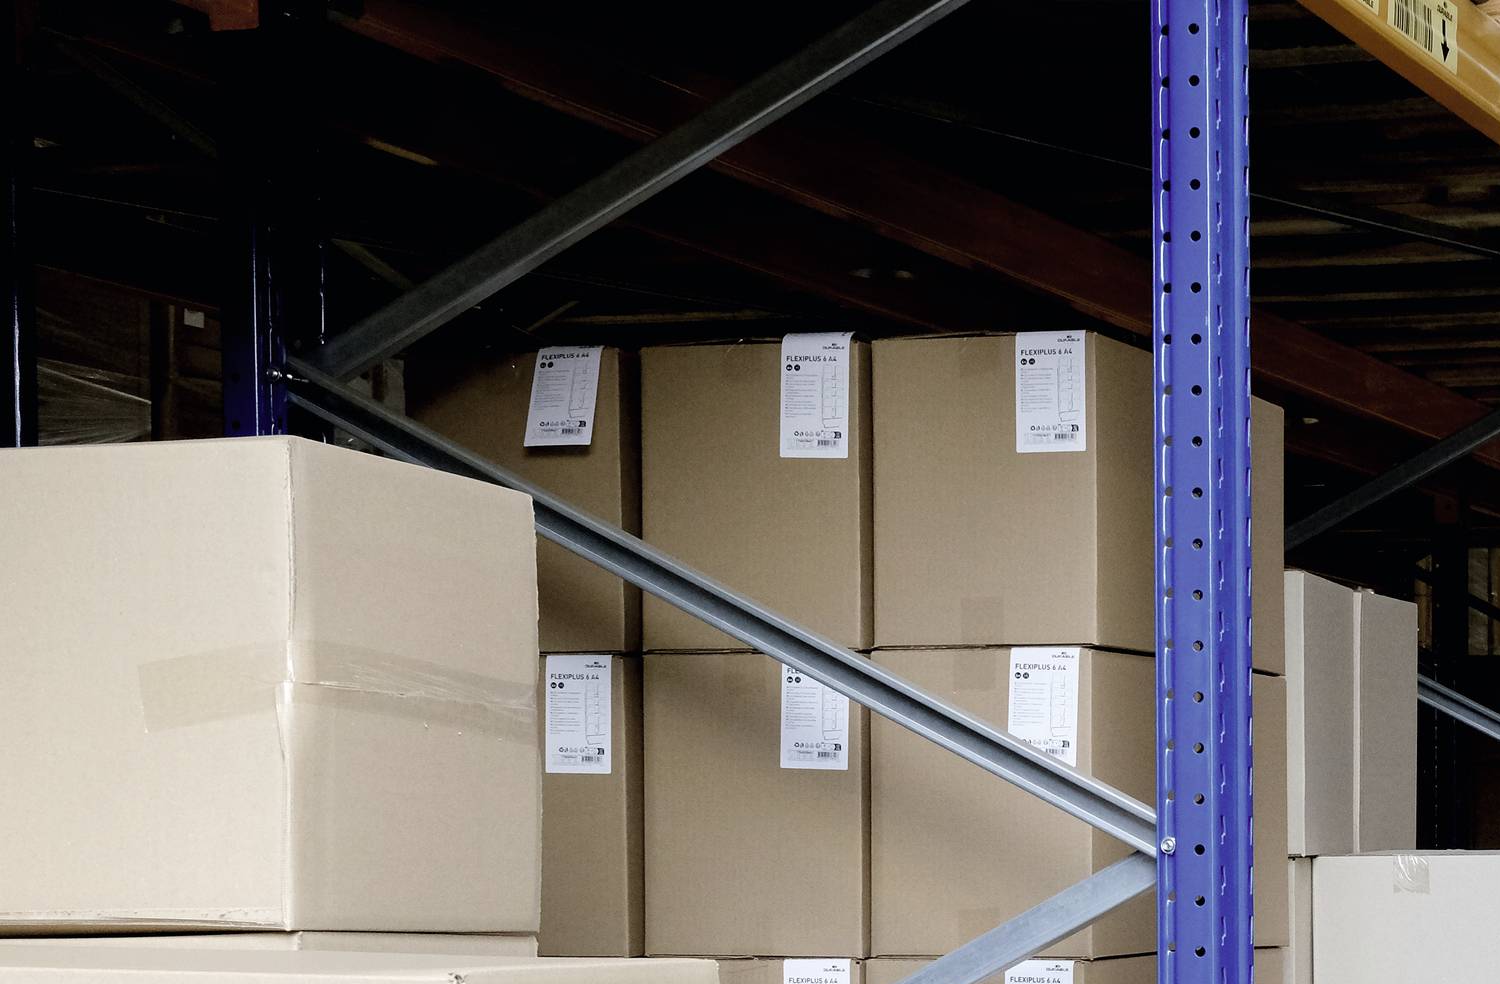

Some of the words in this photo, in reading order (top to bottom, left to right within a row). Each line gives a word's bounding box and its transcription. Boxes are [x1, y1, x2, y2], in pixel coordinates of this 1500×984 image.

[1020, 348, 1056, 356] FLEXIPLUS
[541, 353, 574, 361] FLEXIPLUS
[1015, 662, 1051, 670] FLEXIPLUS
[1010, 976, 1045, 984] FLEXIPLUS
